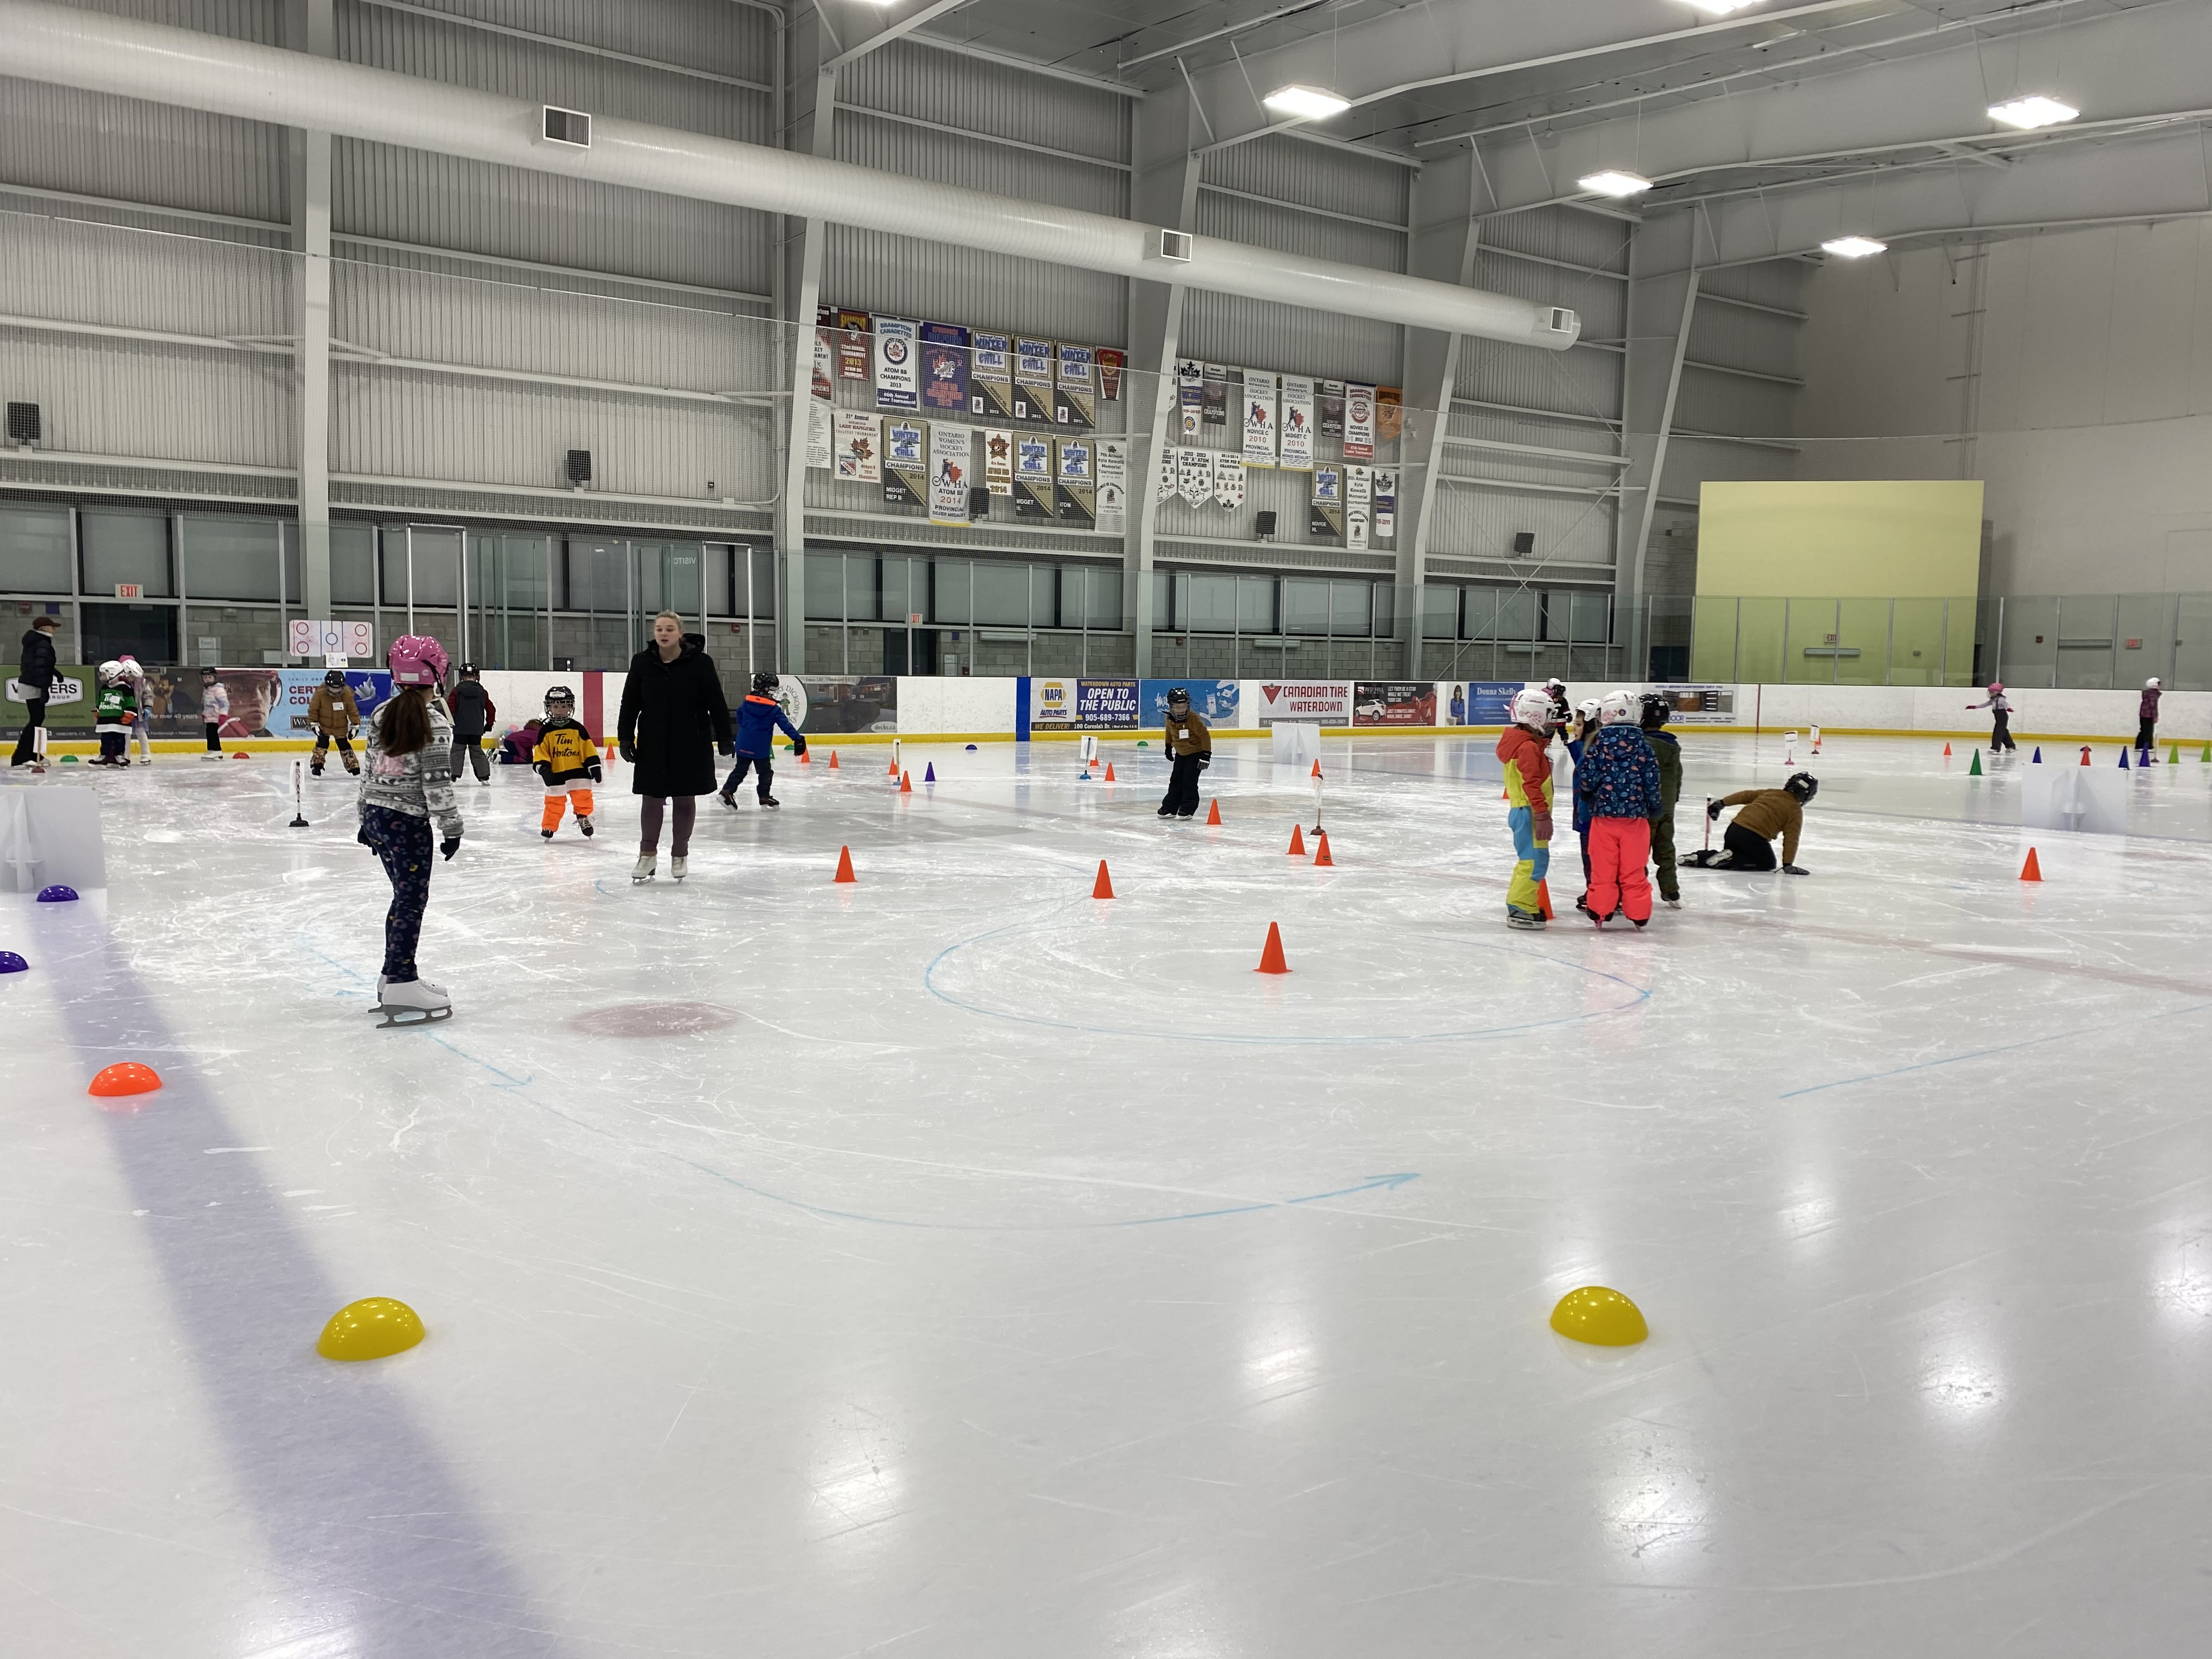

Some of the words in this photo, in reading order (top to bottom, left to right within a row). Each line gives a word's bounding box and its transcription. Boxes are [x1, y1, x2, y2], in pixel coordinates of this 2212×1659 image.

[880, 323, 912, 332] BRAMPTON
[880, 329, 912, 338] CANADETTES
[974, 337, 1007, 351] WINTER
[1018, 343, 1049, 357] WINTER
[1061, 348, 1091, 363] WINTER
[880, 374, 911, 382] CHAMPIONS
[973, 373, 1008, 383] CHAMPIONS
[1016, 379, 1051, 388] CHAMPIONS
[1022, 444, 1045, 453] WINTER
[1063, 448, 1087, 456] WINTER
[886, 461, 924, 471] CHAMPIONS
[1023, 460, 1041, 470] CHILL
[1058, 477, 1092, 486] CHAMPIONS
[990, 485, 1007, 493] 2014
[120, 585, 138, 597] EXIT
[1045, 689, 1063, 701] NAPA
[1087, 688, 1114, 699] OPEN
[1117, 688, 1129, 699] TO
[1283, 686, 1327, 697] CANADIAN
[1329, 686, 1348, 697] TIRE
[1477, 687, 1497, 695] Donna
[1498, 687, 1517, 696] Skelly
[1080, 699, 1099, 710] THE
[1101, 700, 1136, 711] PUBLIC
[1290, 702, 1342, 712] WATERDOWN
[555, 733, 572, 745] Tim
[552, 746, 580, 758] Hortons
